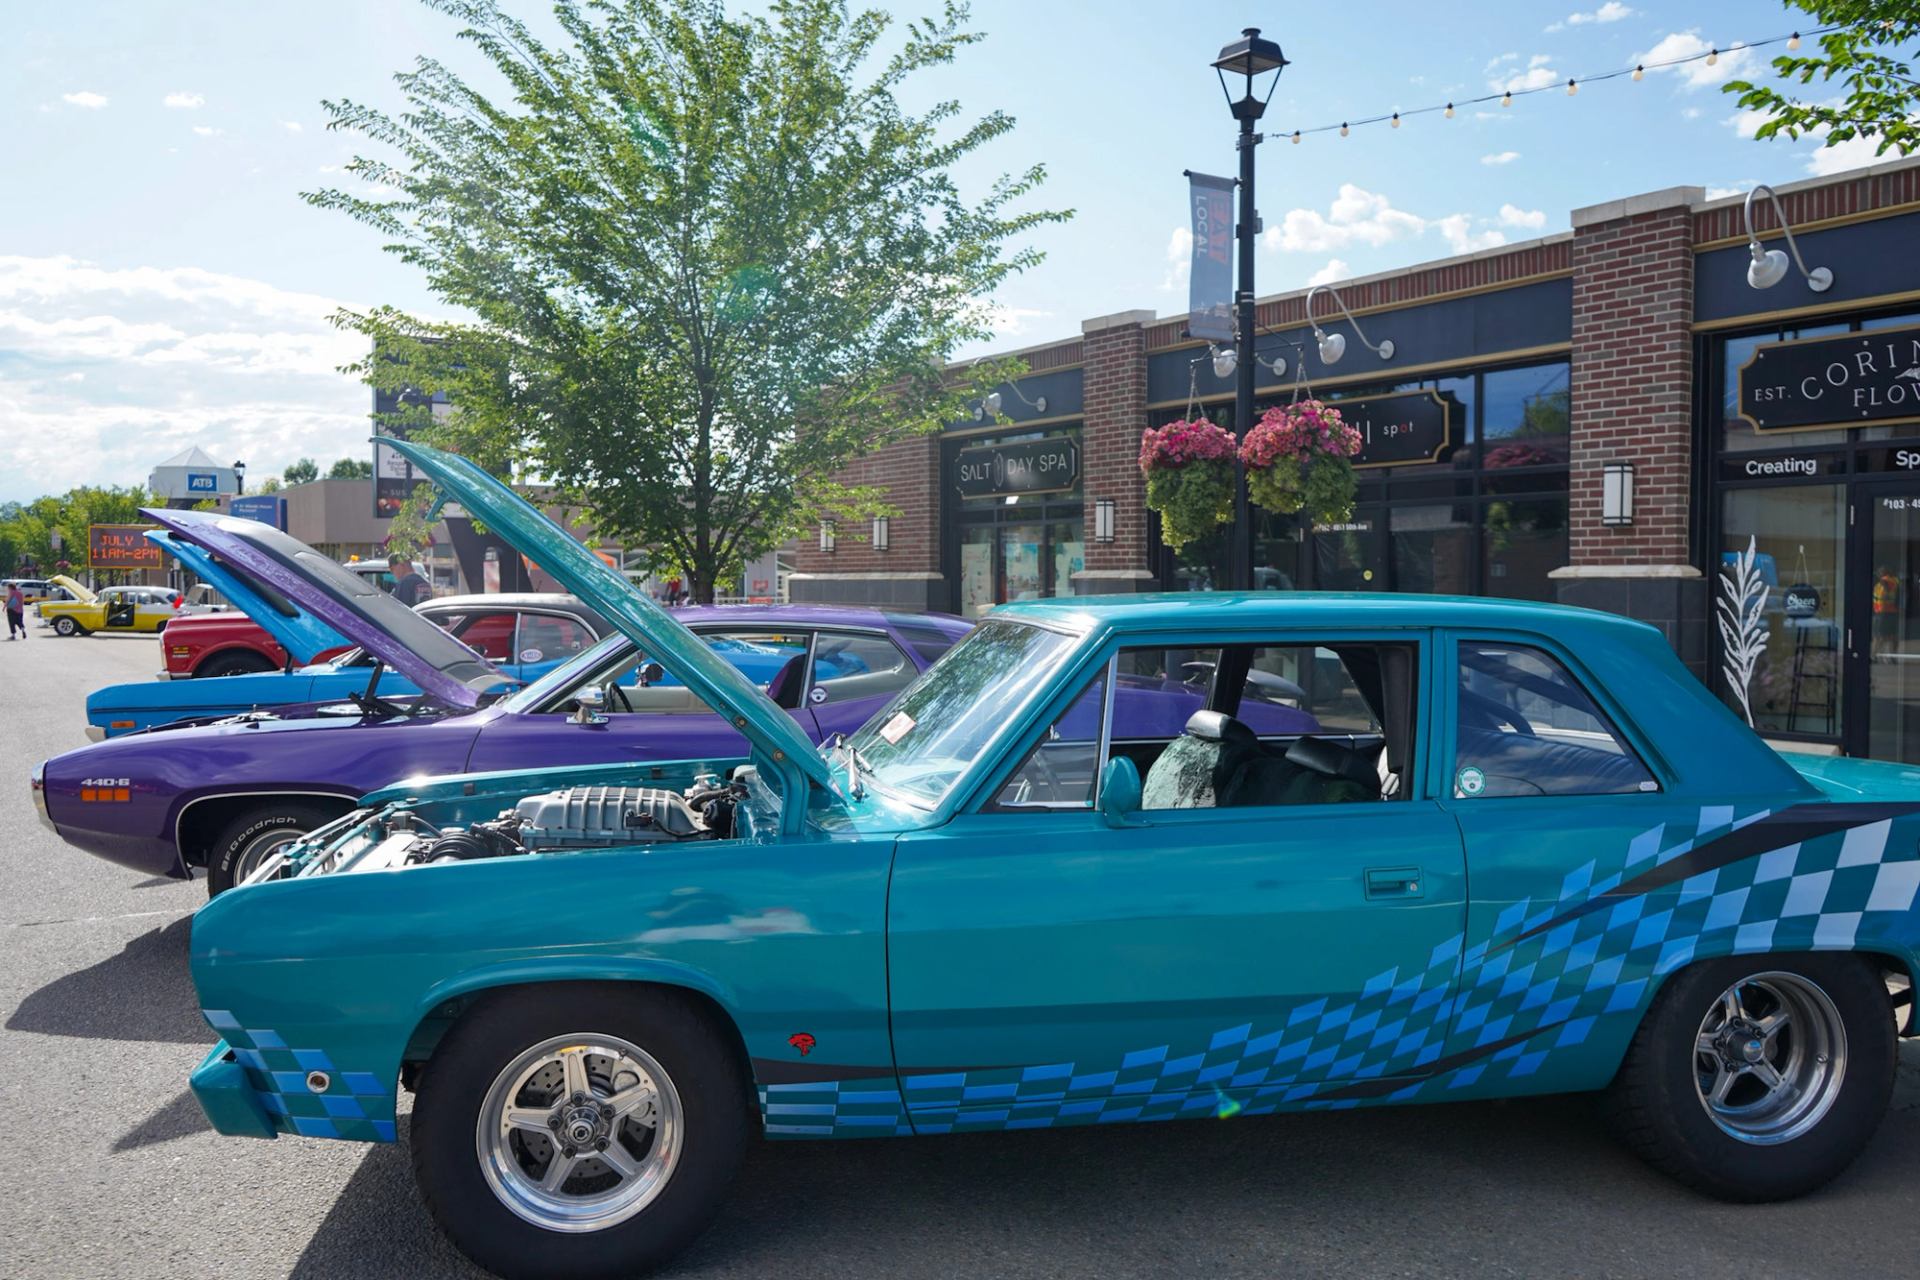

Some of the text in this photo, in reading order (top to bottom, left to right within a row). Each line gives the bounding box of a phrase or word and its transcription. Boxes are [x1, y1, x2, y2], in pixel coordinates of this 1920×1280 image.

[1196, 195, 1208, 259] LOCAL
[1755, 386, 1791, 401] EST.
[1383, 421, 1413, 438] spot
[961, 453, 1067, 481] SALT DAY SPA
[1745, 457, 1817, 475] Creating
[192, 478, 213, 488] ATB
[1883, 498, 1905, 509] #103
[101, 535, 134, 546] JULY
[92, 547, 159, 560] 11AM-2PM
[1787, 593, 1816, 609] Open
[221, 816, 297, 871] BFGoodrich
